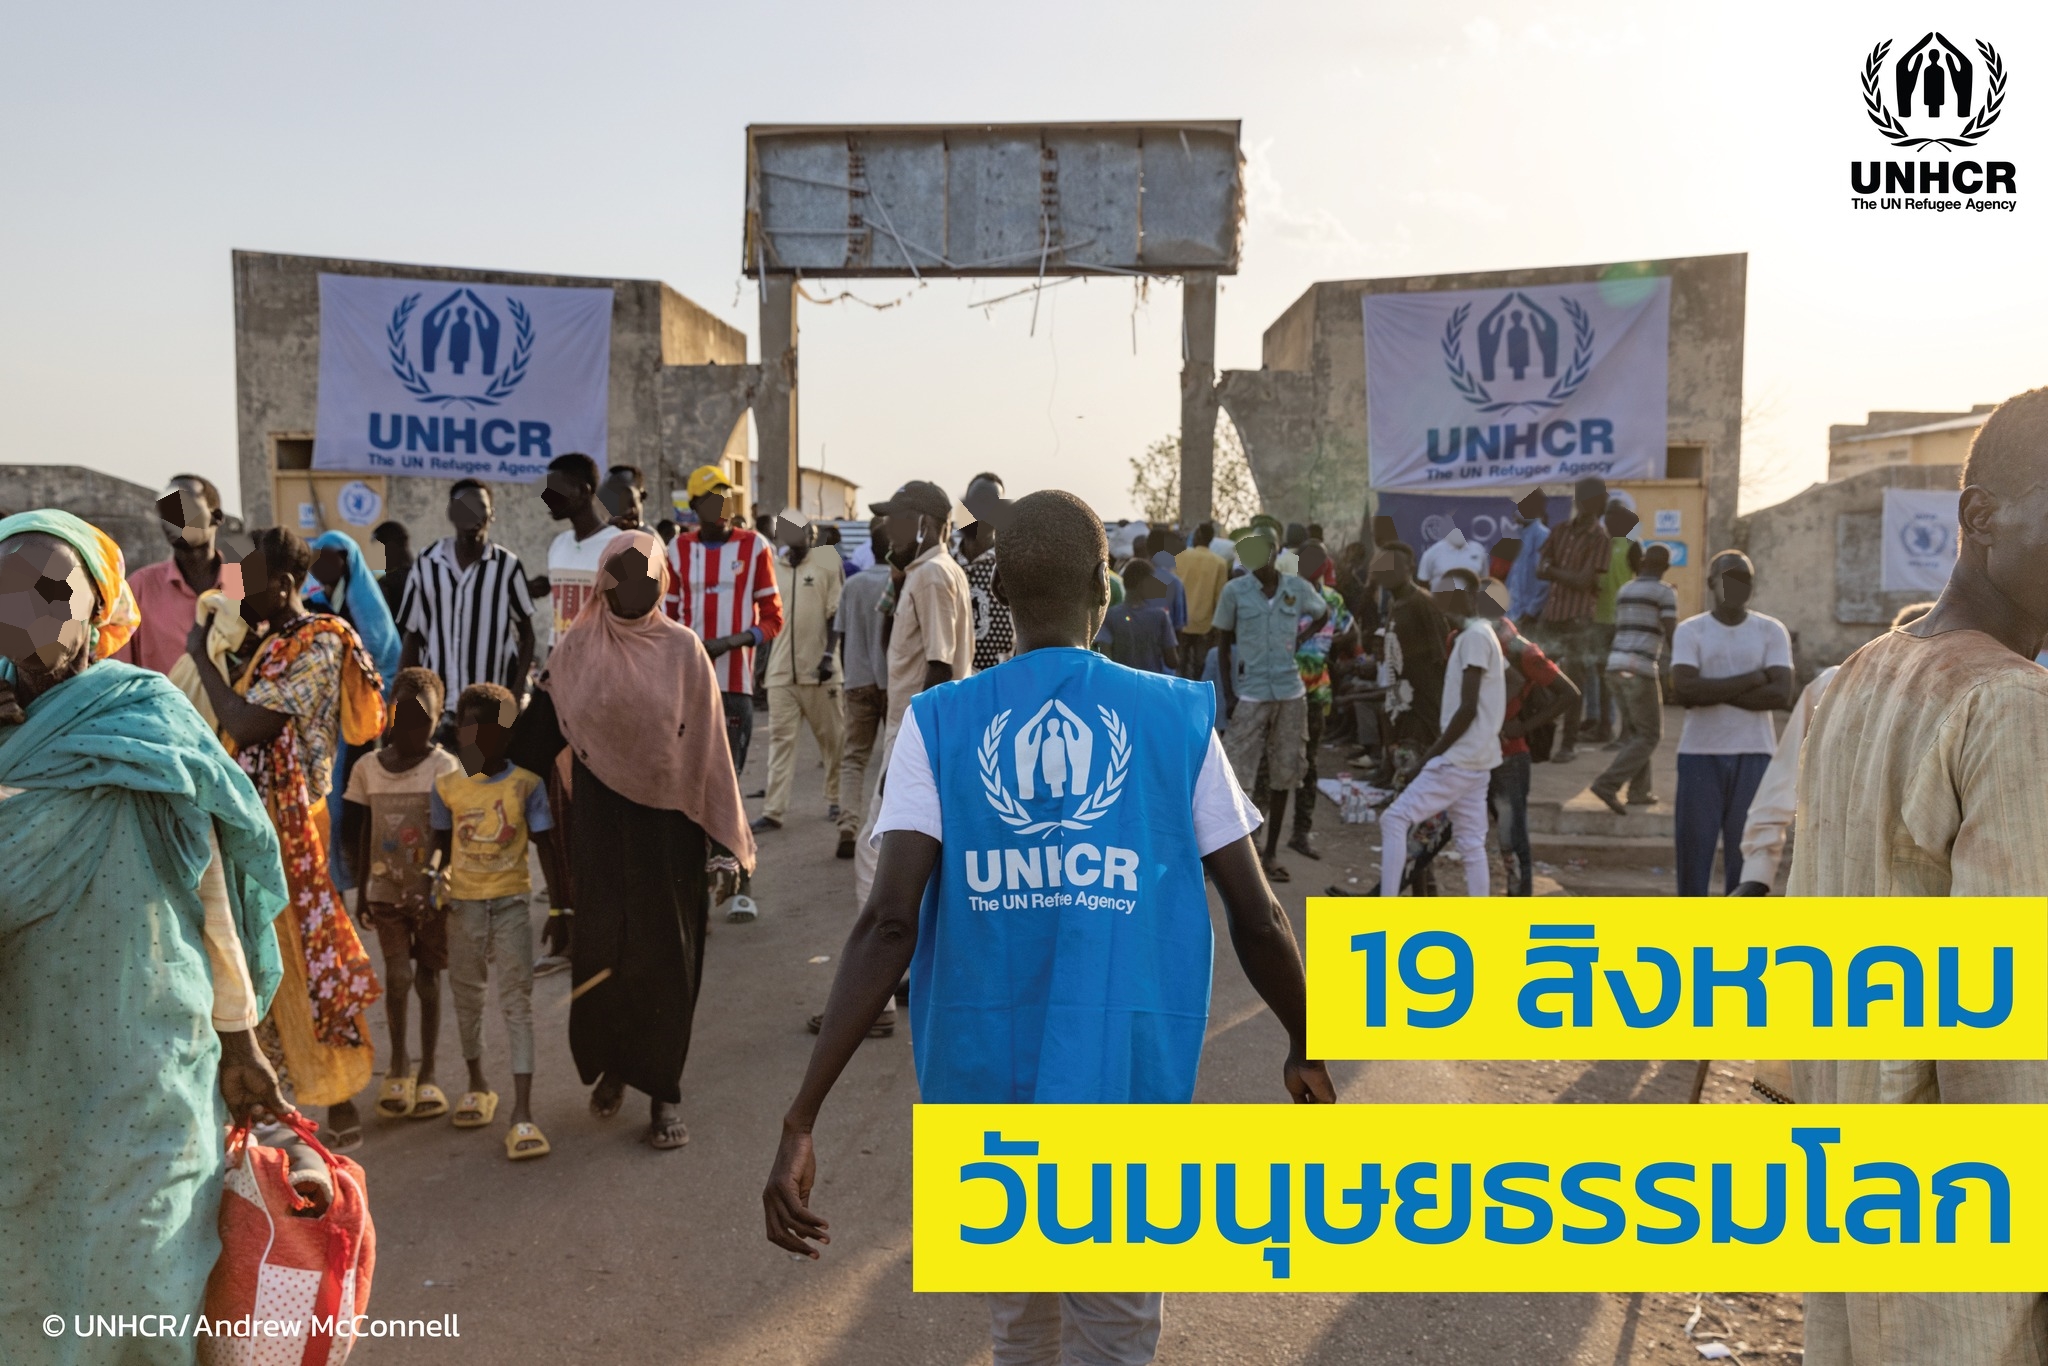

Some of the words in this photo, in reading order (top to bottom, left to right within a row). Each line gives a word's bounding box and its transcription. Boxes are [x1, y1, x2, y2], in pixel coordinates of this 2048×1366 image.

[369, 412, 553, 458] UNHCR
[1427, 417, 1615, 465] UNHCR
[367, 453, 395, 467] The
[402, 456, 424, 468] UN
[430, 457, 492, 473] Refugee
[498, 460, 547, 477] Agenc
[1426, 468, 1453, 481] The
[1460, 466, 1482, 479] UN
[1489, 464, 1551, 479] Refugee
[1558, 459, 1615, 476] Agency
[968, 895, 1000, 912] The
[1002, 894, 1028, 910] UN
[1075, 890, 1136, 915] Agency
